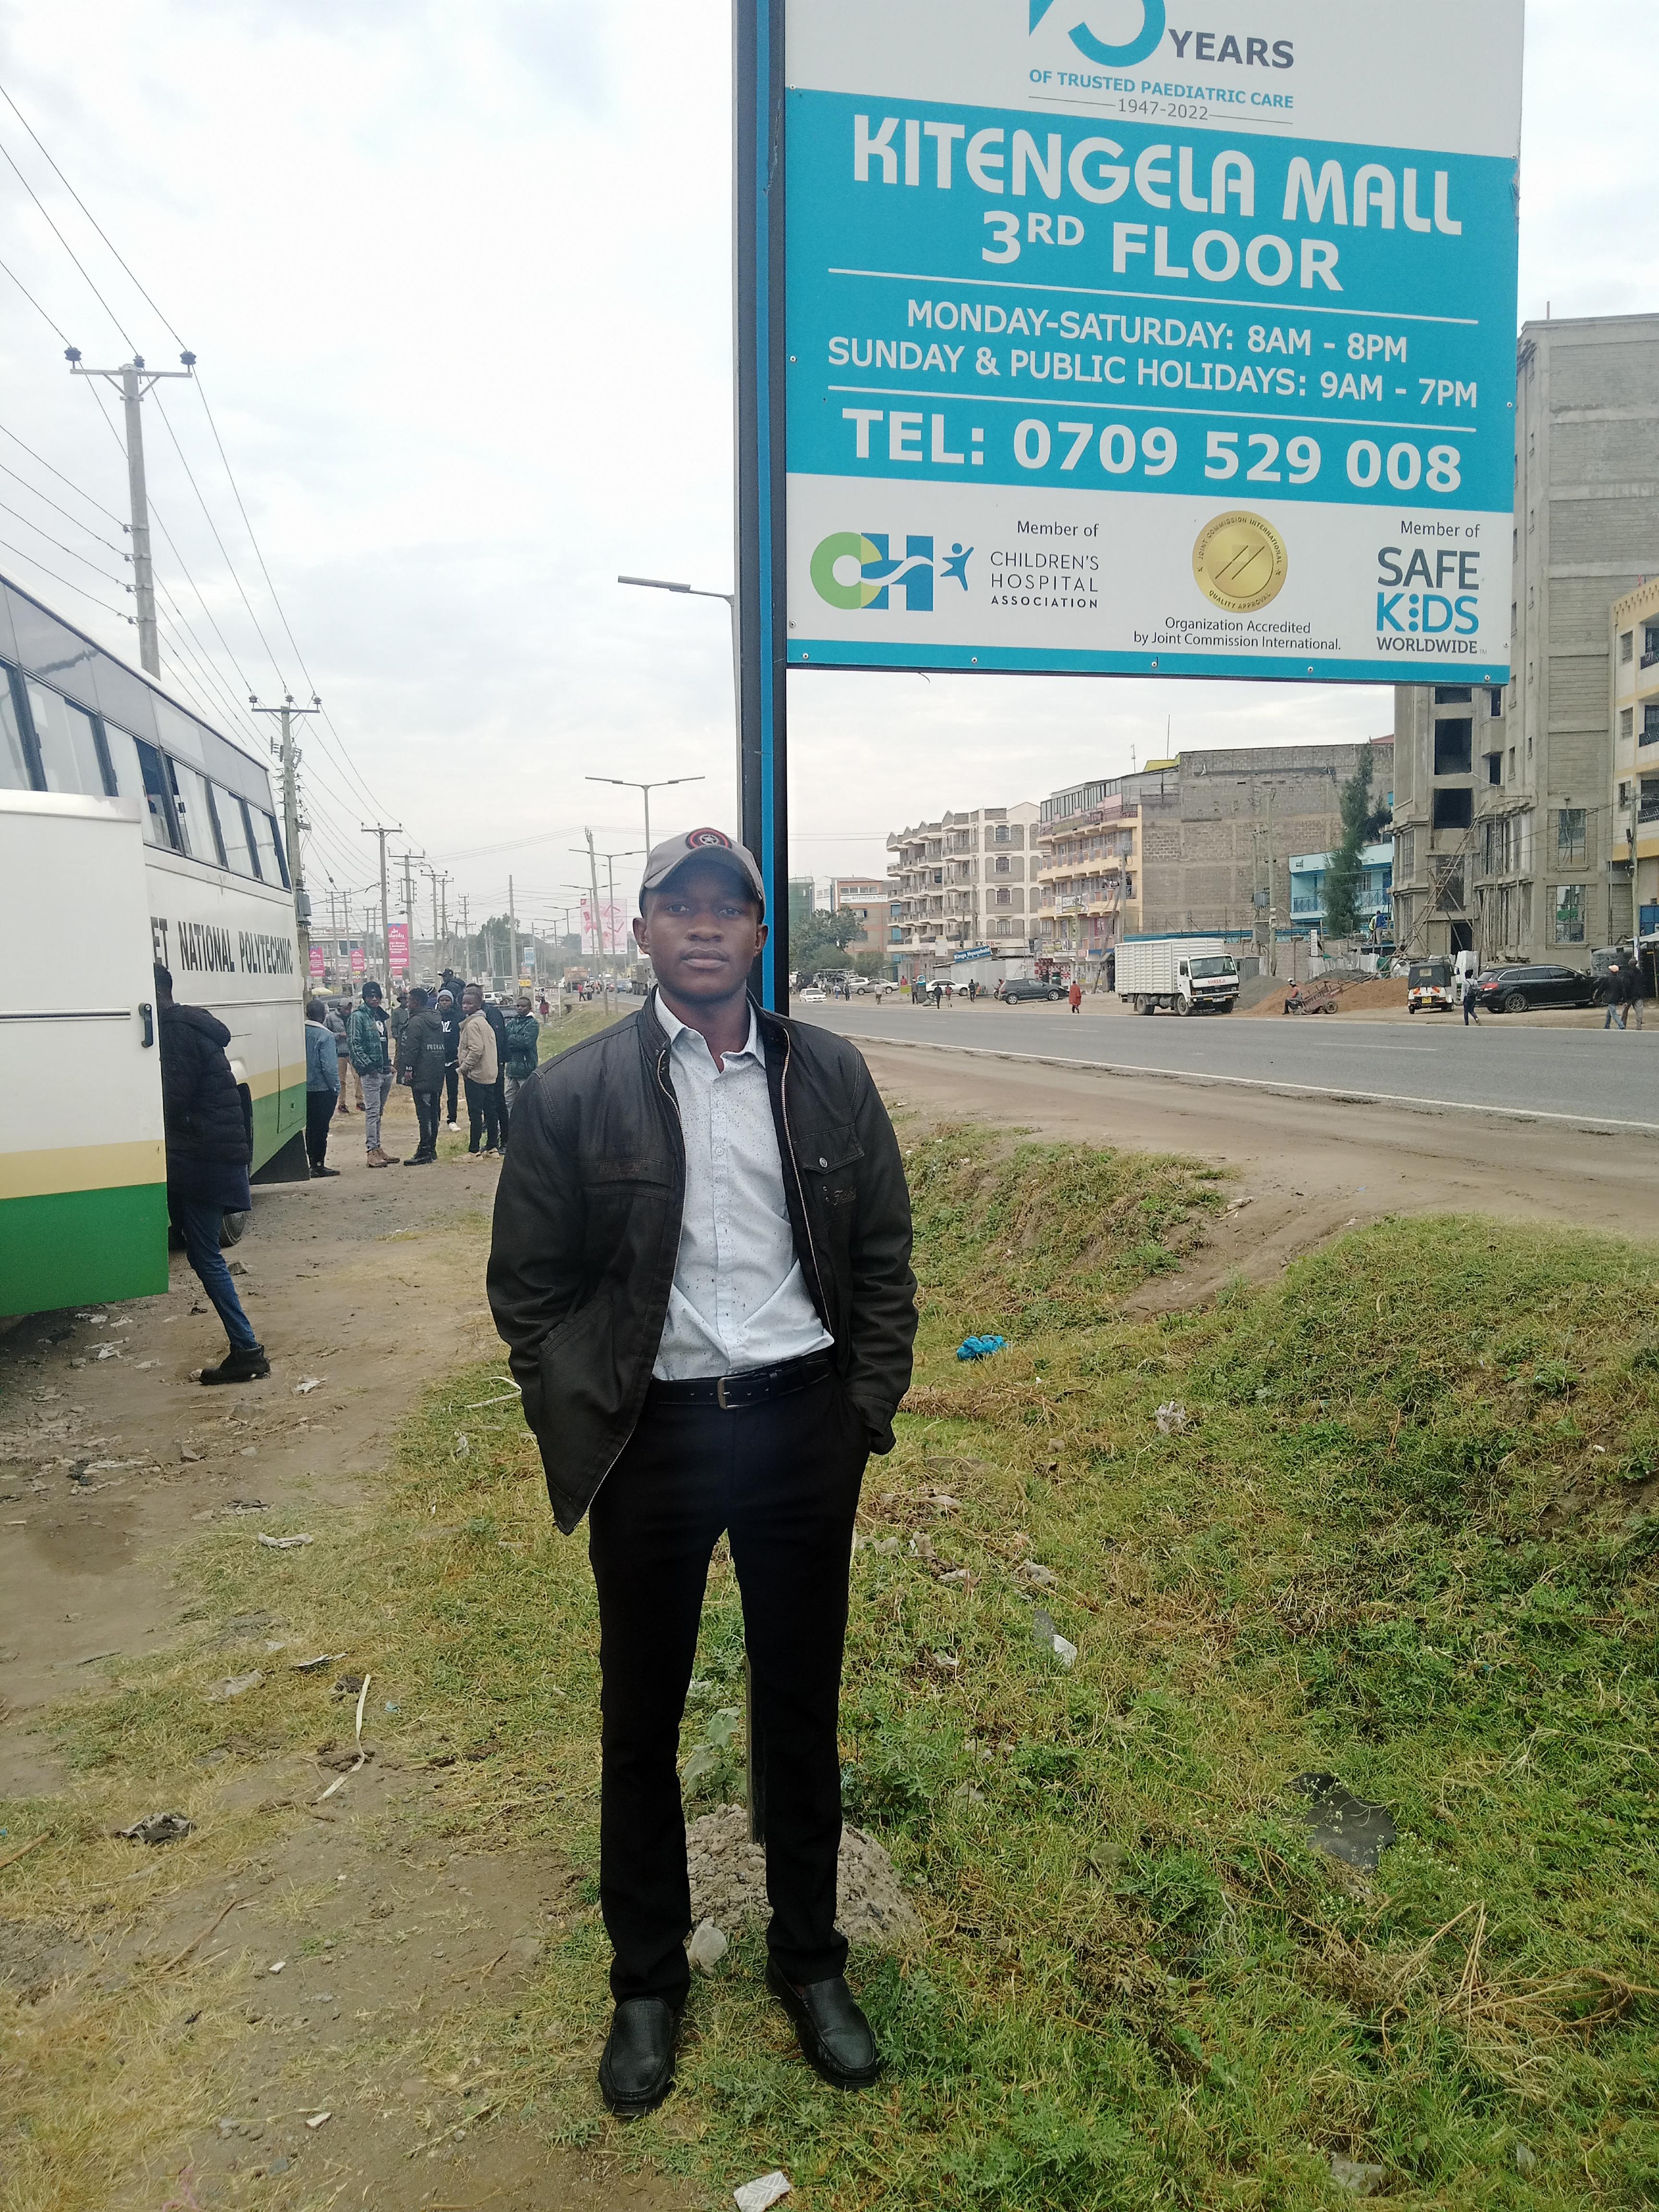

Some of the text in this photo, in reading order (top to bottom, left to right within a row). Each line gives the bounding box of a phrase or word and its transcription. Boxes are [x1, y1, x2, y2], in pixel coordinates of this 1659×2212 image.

[1168, 29, 1294, 69] YEARS
[1029, 69, 1294, 108] OF TRUSTED PAEDIATRIC CARE
[1118, 98, 1208, 120] 1947-2022
[854, 114, 1463, 235] KITENGELA MALL
[982, 210, 1344, 291] 3RD FLOOR
[908, 299, 1233, 349] MONDAY-SATURDAY:
[1248, 325, 1311, 356] 8AM
[1347, 333, 1407, 363] 8PM
[829, 337, 965, 373] SUNDAY
[975, 347, 1000, 375] &
[1011, 349, 1126, 384] PUBLIC
[1138, 358, 1305, 396] HOLIDAYS:
[1320, 371, 1382, 401] 9AM
[1419, 378, 1477, 408] 7PM
[842, 408, 1461, 493] TEL: 0709 529 008
[1018, 520, 1099, 537] Member of
[1401, 521, 1480, 538] Member of
[1199, 517, 1282, 564] JOINT COMMISSION INTERNATIONAL
[990, 552, 1099, 570] CHILDREN'S
[1378, 547, 1480, 590] SAFE
[991, 574, 1098, 592] HOSPITAL
[991, 595, 1098, 609] ASSOCIATION
[1209, 590, 1271, 609] QUALITY APPROVAL
[1165, 617, 1311, 633] Organization Accredited
[1134, 631, 1342, 650] by Joint Commission International.
[1377, 637, 1478, 654] WORLDWIDE
[178, 921, 235, 973] NATIONAL
[239, 931, 293, 974] POLYTECHNIC
[967, 947, 990, 957] Household
